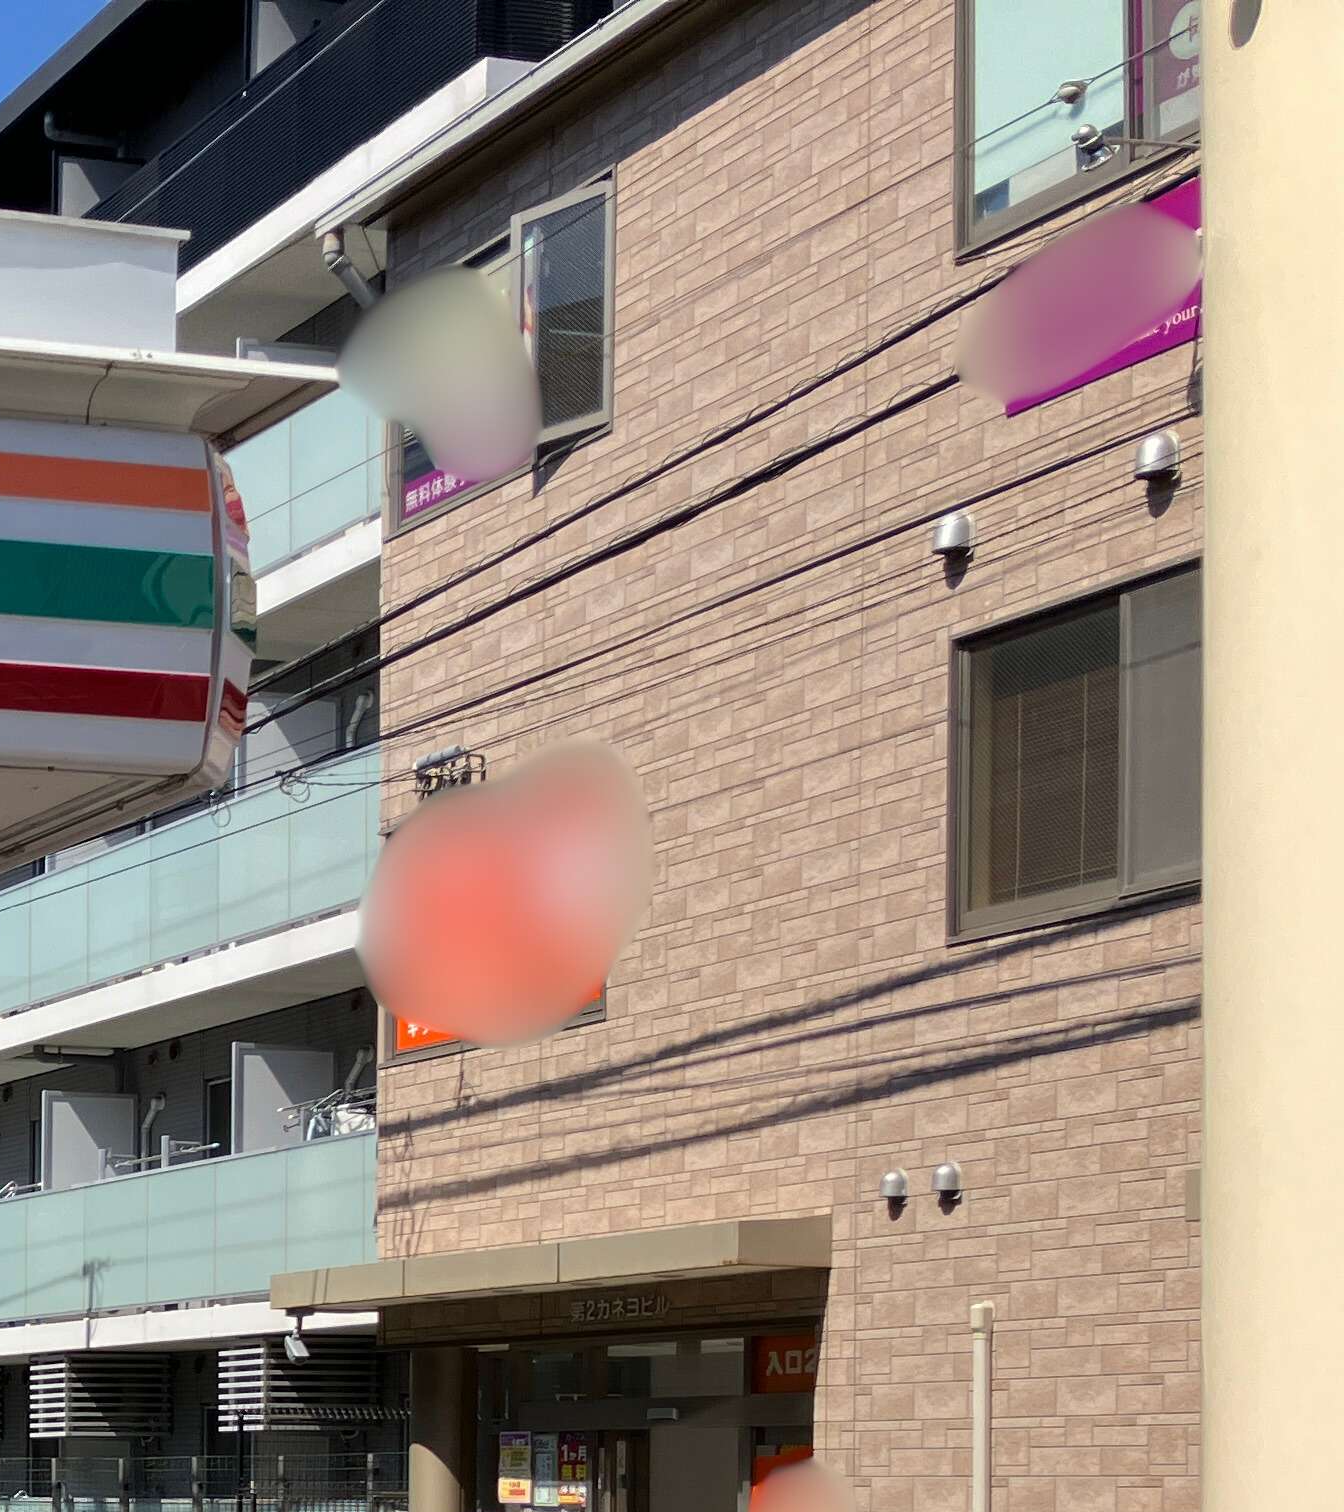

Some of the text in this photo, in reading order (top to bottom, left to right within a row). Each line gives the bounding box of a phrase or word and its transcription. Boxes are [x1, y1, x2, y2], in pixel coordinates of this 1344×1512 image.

[570, 1295, 672, 1322] 第2カネヨビル
